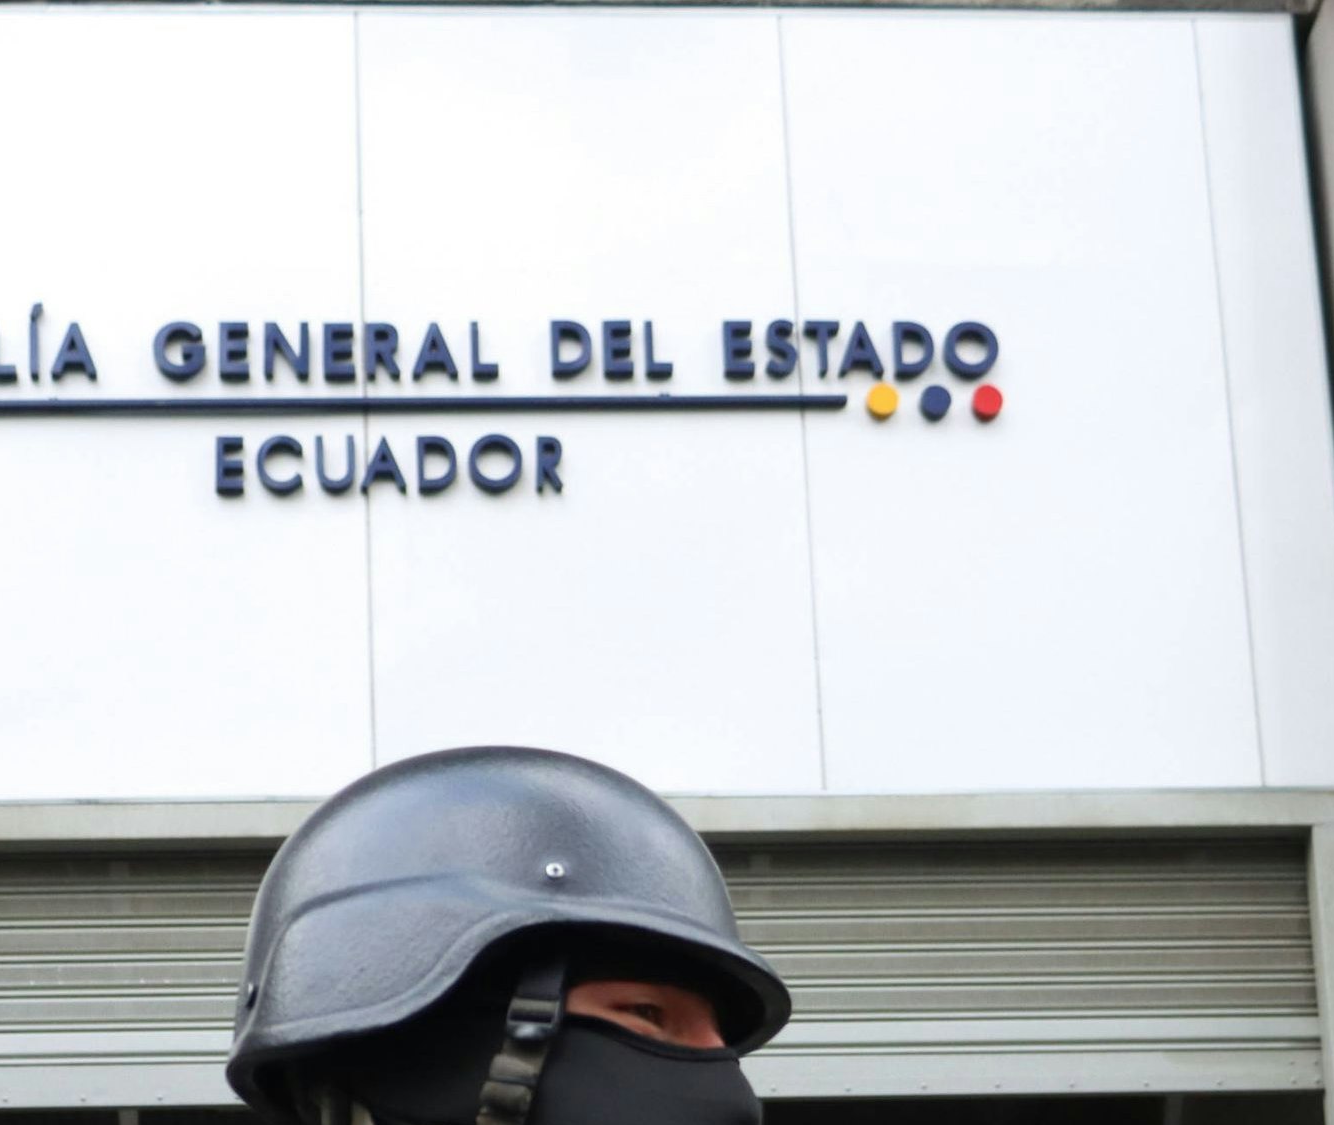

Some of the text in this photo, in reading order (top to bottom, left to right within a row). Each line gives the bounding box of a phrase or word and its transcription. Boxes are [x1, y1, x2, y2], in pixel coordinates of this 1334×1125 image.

[152, 320, 500, 383] GENERAL
[549, 319, 674, 381] DEL
[722, 319, 1000, 381] ESTADO
[214, 433, 564, 496] ECUADOR
